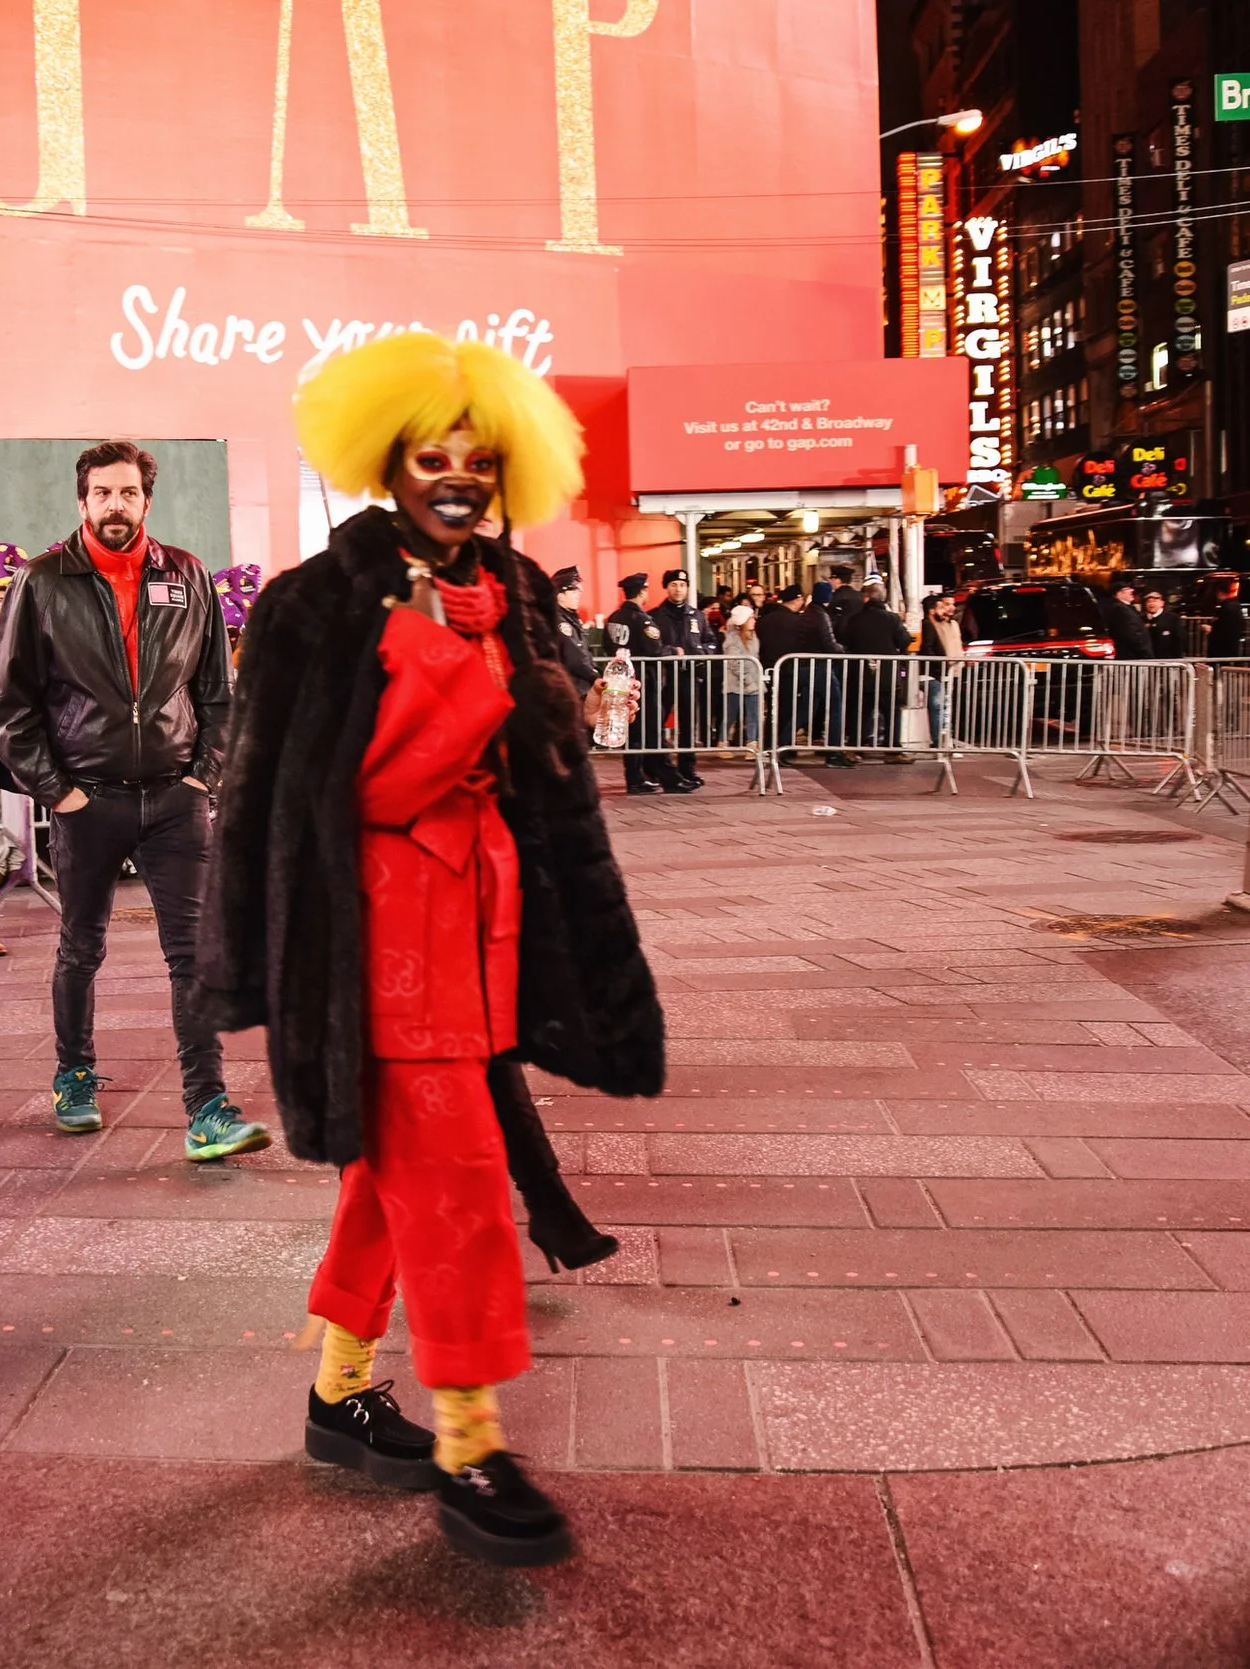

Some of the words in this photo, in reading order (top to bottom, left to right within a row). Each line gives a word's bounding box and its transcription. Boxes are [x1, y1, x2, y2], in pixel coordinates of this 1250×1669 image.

[1171, 104, 1191, 157] TIMES
[1175, 160, 1191, 201] DELI
[920, 168, 942, 266] PARK
[110, 284, 286, 370] Share
[298, 318, 435, 386] yo
[745, 400, 786, 414] Can't
[789, 399, 831, 413] wait?
[684, 421, 718, 434] Visit
[720, 422, 739, 433] us
[742, 420, 758, 432] at
[760, 418, 799, 431] 42nd
[801, 417, 813, 430] &
[816, 416, 893, 430] Broadway
[724, 440, 742, 451] or
[744, 439, 765, 452] go
[767, 438, 784, 449] to
[786, 436, 853, 451] gap.com
[1133, 446, 1166, 462] Deli
[1084, 460, 1116, 474] Deli
[1129, 472, 1168, 489] Café
